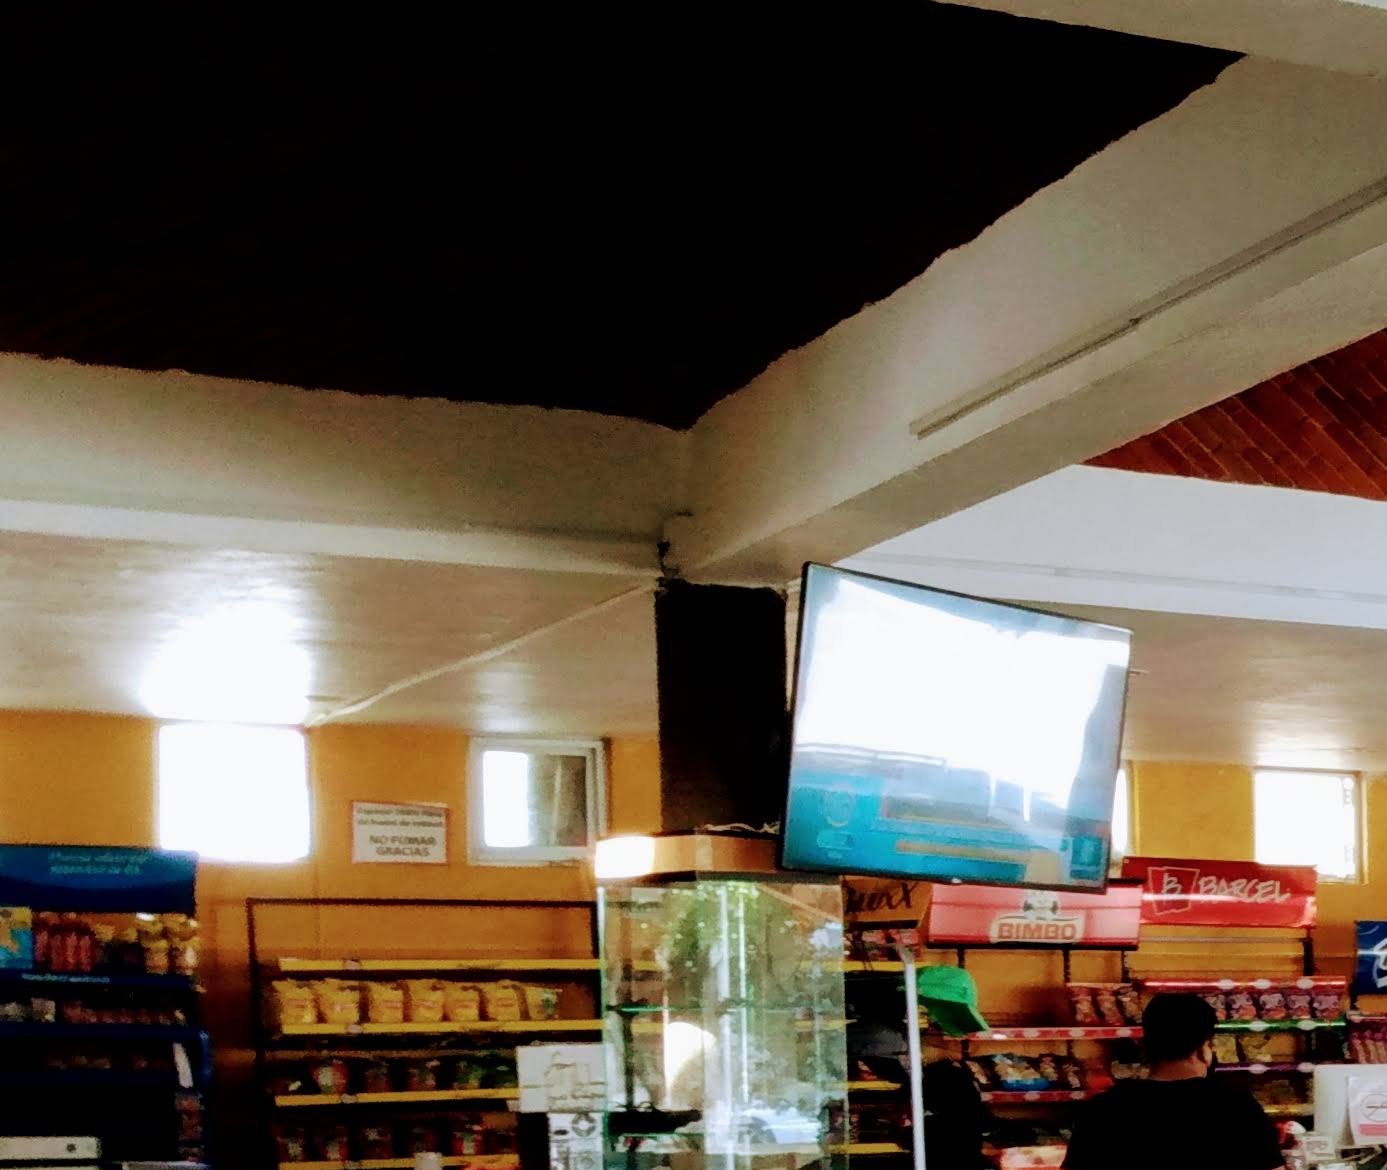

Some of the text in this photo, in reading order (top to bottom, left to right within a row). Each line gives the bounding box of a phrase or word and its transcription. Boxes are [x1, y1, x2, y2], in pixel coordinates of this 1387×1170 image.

[390, 835, 437, 847] FUMAR
[376, 847, 431, 857] GRACIAS
[1198, 875, 1291, 904] BARCEL
[997, 921, 1077, 941] BIMBO
